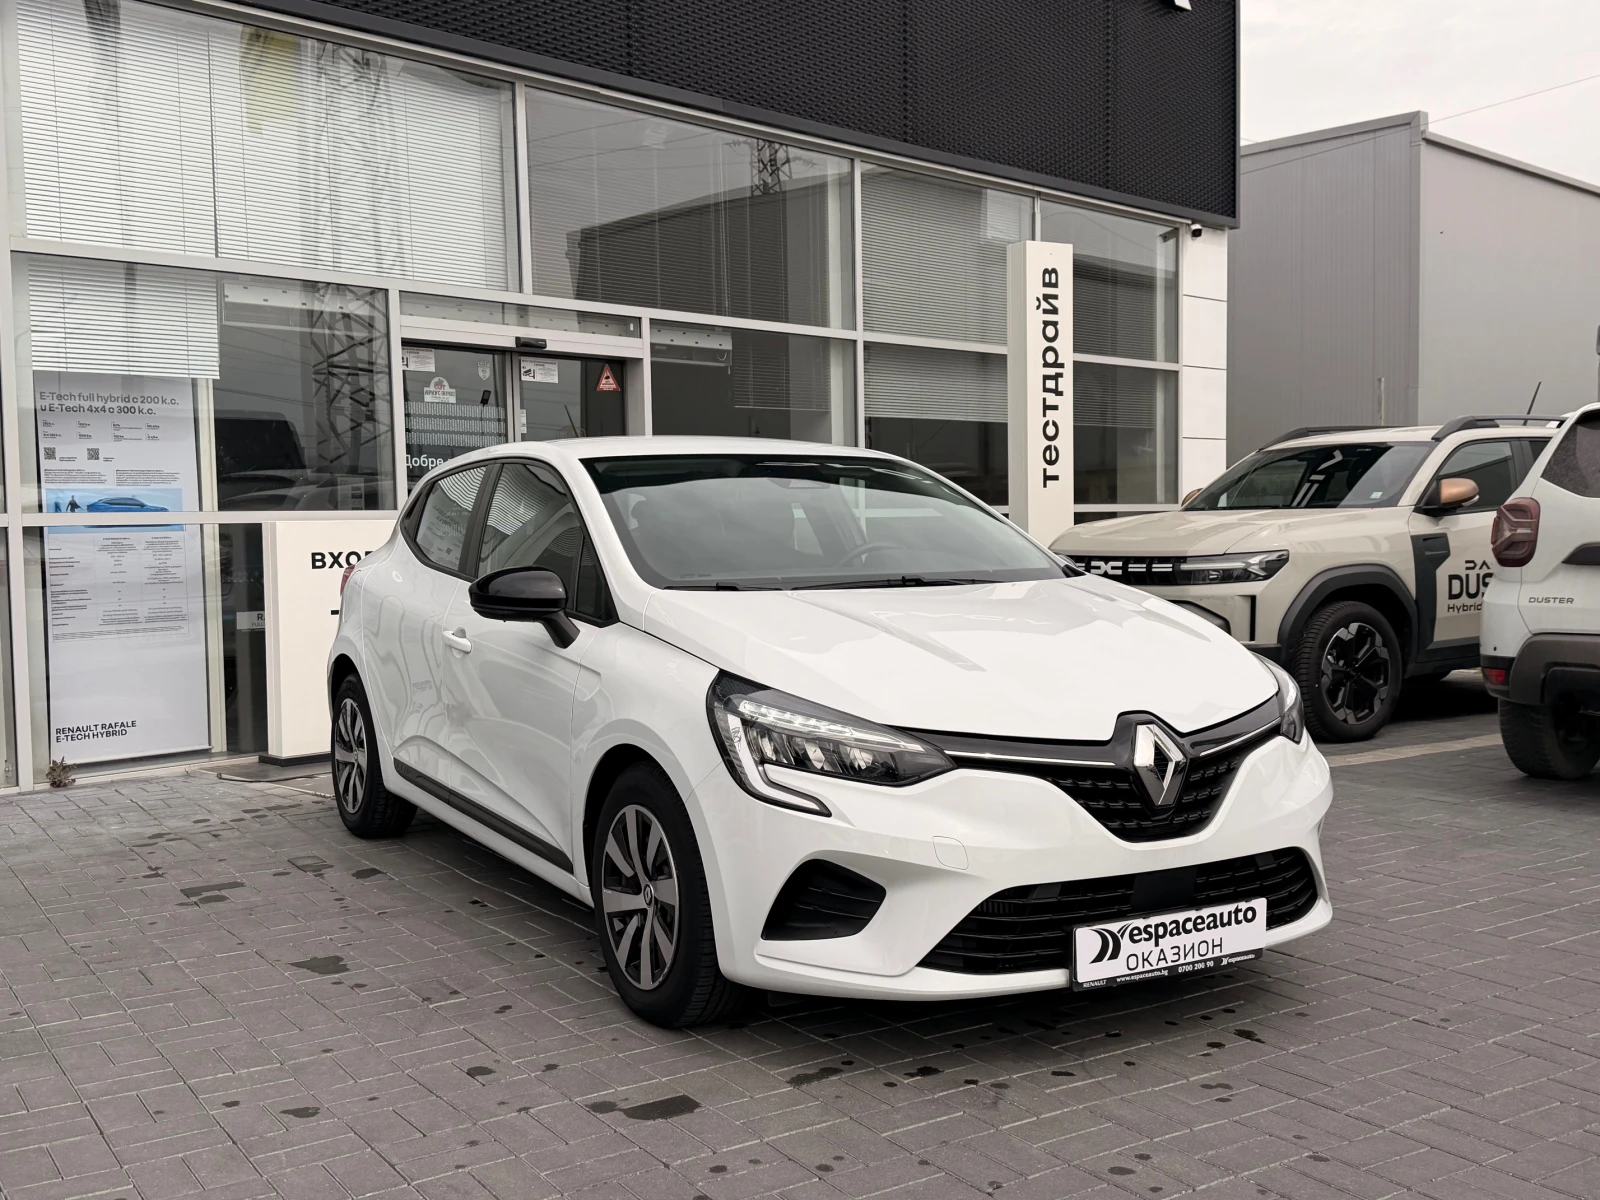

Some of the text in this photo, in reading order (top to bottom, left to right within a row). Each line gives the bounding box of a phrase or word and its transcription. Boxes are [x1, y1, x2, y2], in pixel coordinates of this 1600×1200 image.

[40, 391, 76, 401] E-Tech
[78, 392, 95, 402] full
[96, 393, 130, 404] hybrid
[140, 395, 160, 404] 200
[48, 403, 85, 412] E-Tech
[116, 405, 136, 414] 300
[311, 550, 374, 570] ВХО
[1447, 602, 1483, 614] Hybrid
[1528, 596, 1575, 605] DUSTER
[55, 720, 137, 735] RENAULT RAFALE
[56, 728, 128, 743] E-TECH HYBRID
[1128, 904, 1257, 948] espaceauto
[1126, 937, 1223, 971] ОКАЗИОН
[1082, 979, 1107, 988] RENAULT
[1116, 969, 1169, 983] www.espaceauto.bg
[1178, 964, 1193, 973] 0700
[1194, 961, 1205, 970] 200
